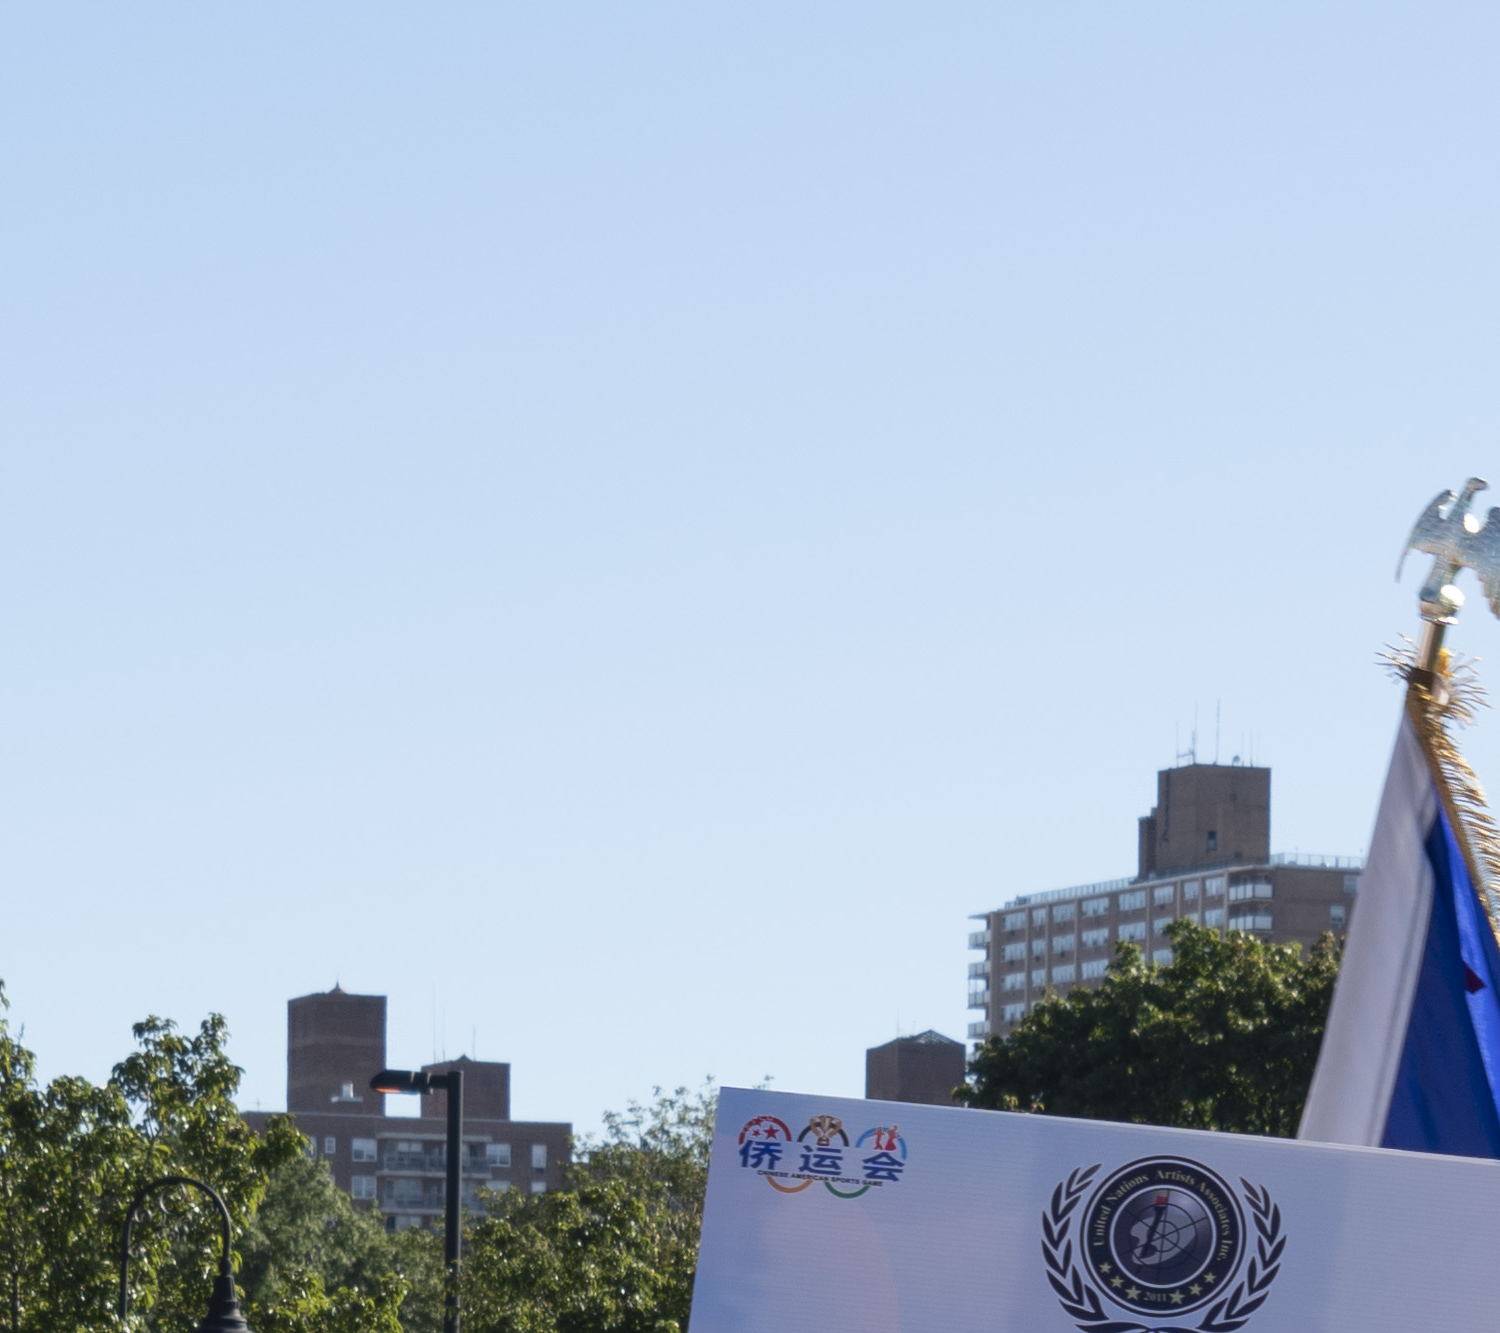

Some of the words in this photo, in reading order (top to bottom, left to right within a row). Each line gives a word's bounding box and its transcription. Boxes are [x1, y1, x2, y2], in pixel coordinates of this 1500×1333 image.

[739, 1140, 905, 1181] 侨运会
[757, 1169, 789, 1178] CHINESE
[791, 1173, 829, 1182] AMERICAN
[831, 1177, 860, 1185] SPORTS
[862, 1179, 883, 1187] GAME
[1093, 1205, 1111, 1246] United
[1106, 1174, 1149, 1202] Nations
[1155, 1169, 1196, 1185] Artists
[1195, 1182, 1231, 1236] Associates
[1217, 1240, 1233, 1261] Inc.
[1144, 1292, 1167, 1302] 2011
